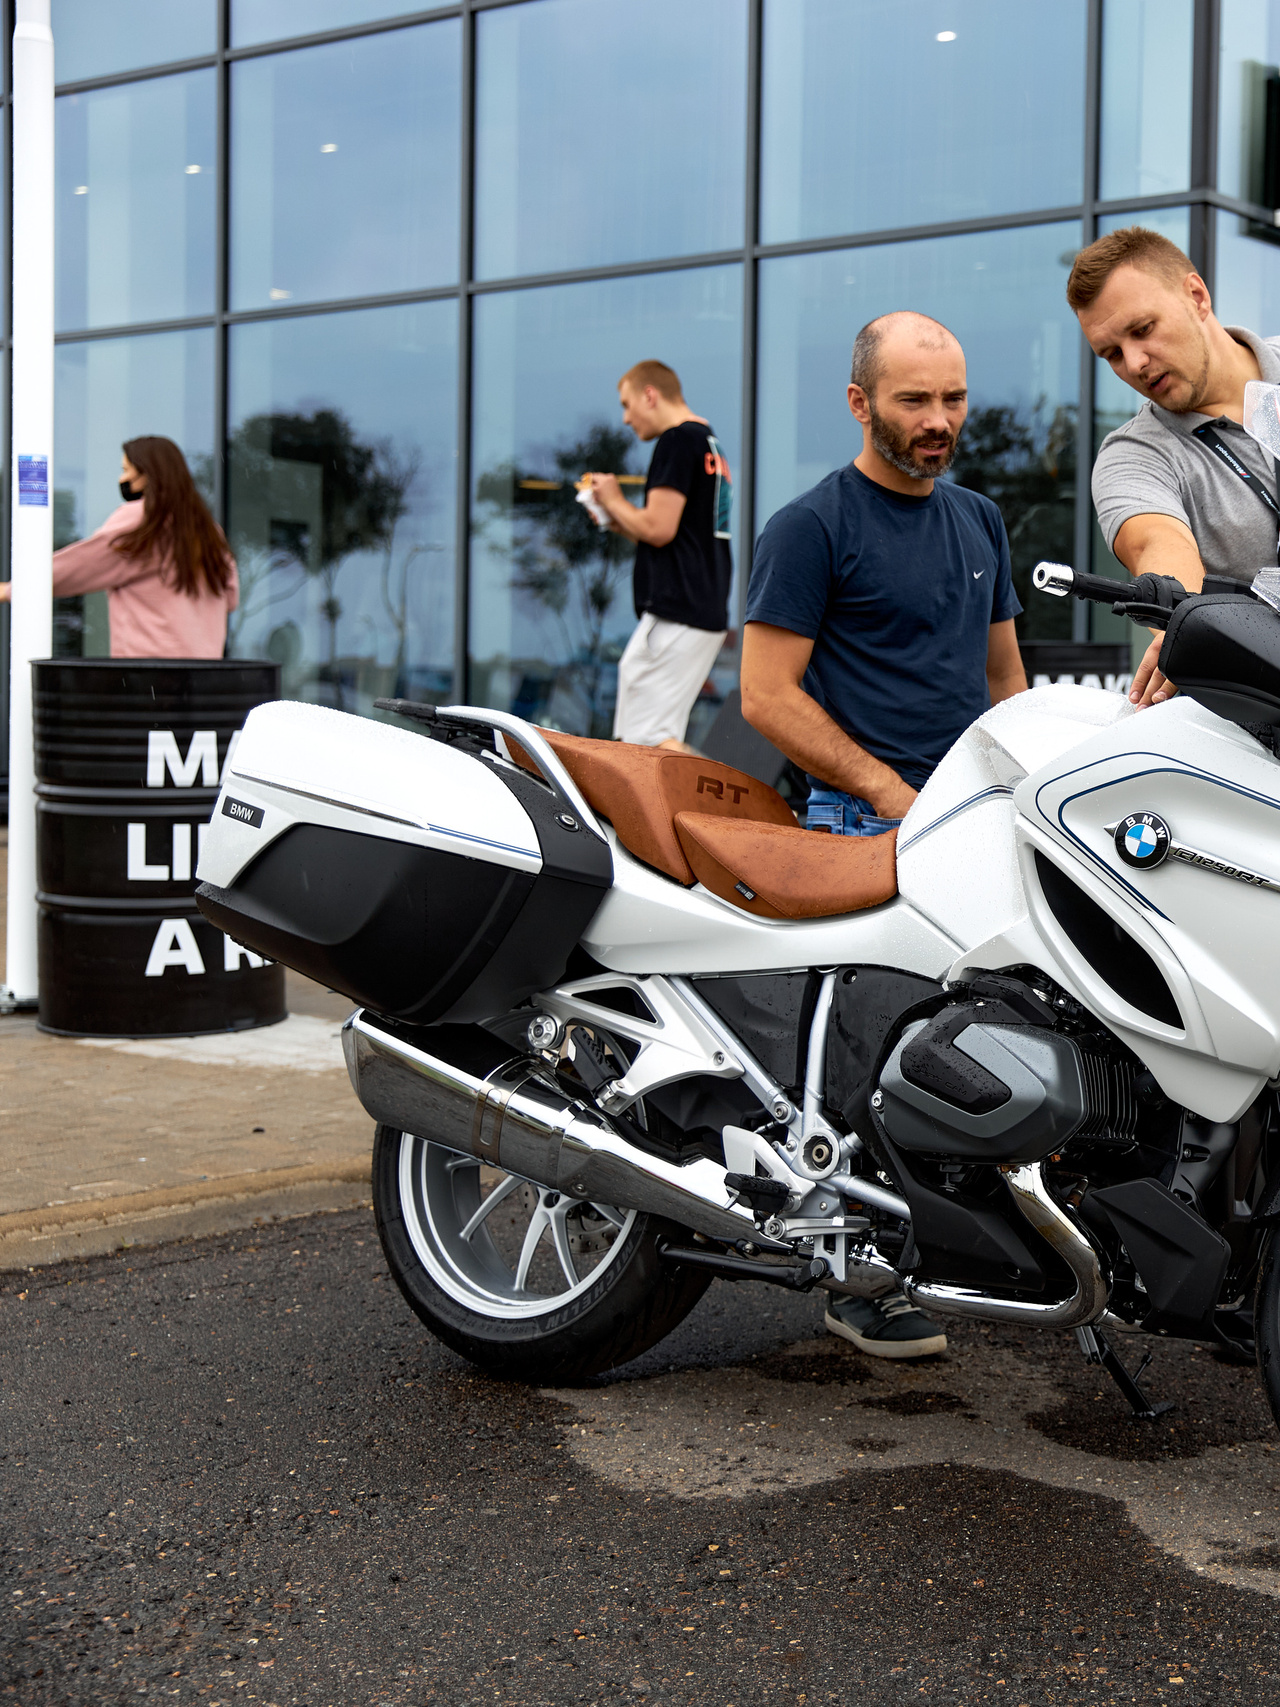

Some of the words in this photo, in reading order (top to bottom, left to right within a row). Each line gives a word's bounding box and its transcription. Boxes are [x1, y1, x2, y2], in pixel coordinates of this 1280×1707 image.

[696, 775, 749, 805] RT
[229, 802, 255, 822] BMW
[1124, 814, 1167, 840] BMW
[145, 918, 206, 977] A
[544, 1239, 635, 1330] MICHELIN
